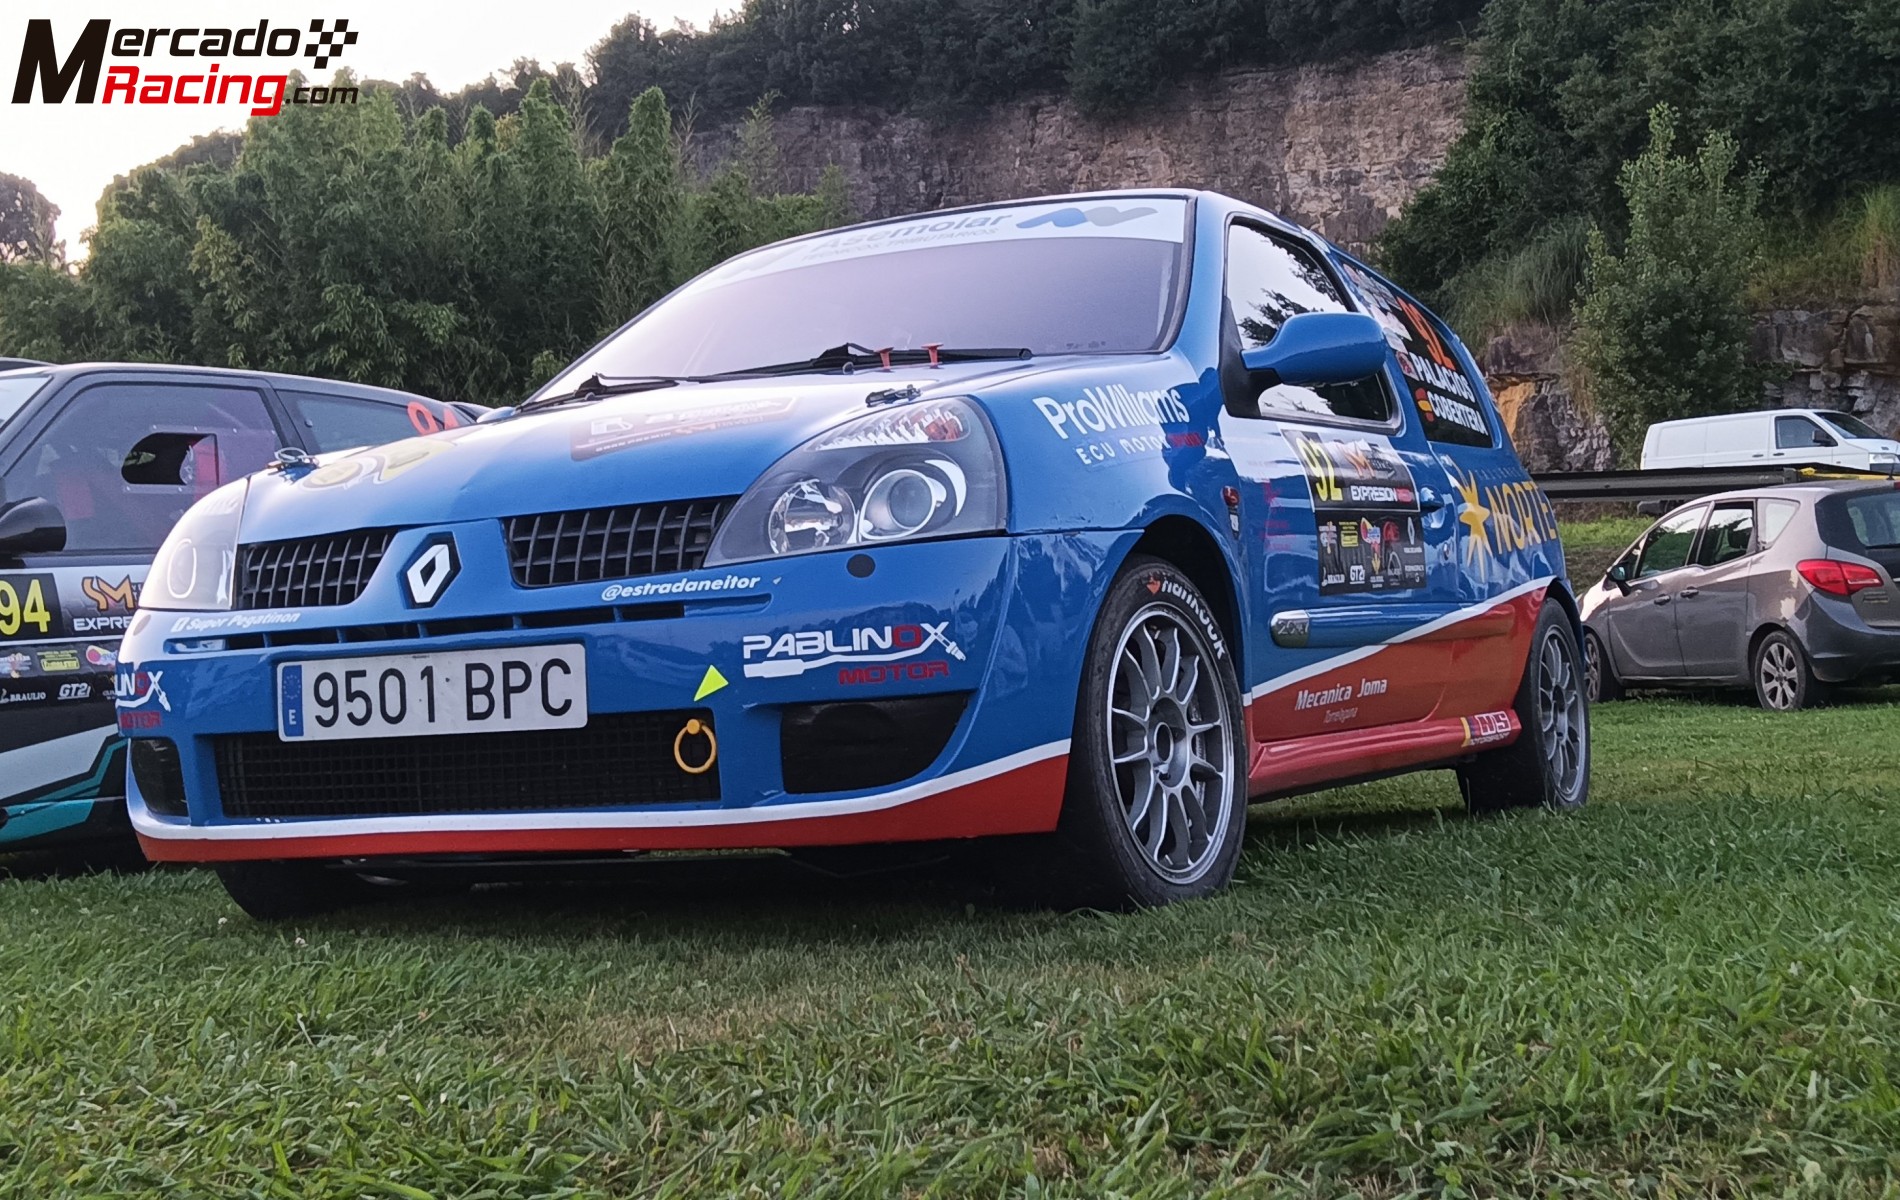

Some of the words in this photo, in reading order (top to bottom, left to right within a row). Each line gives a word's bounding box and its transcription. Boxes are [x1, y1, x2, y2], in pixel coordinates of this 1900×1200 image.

[811, 214, 1013, 252] Asemolar
[1408, 350, 1476, 403] PALACIOS
[1427, 390, 1489, 436] COBERTERA
[1076, 439, 1116, 465] ECU
[1119, 433, 1172, 456] MOTOR
[1296, 437, 1343, 501] 92
[601, 574, 761, 600] @estradaneitor
[0, 578, 51, 636] 94
[743, 621, 950, 660] PABLINOX
[838, 661, 949, 685] MOTOR
[10, 691, 47, 703] BRAULIO
[288, 709, 297, 725] E
[313, 665, 435, 728] 9501
[465, 658, 573, 721] BPC
[1294, 683, 1353, 711] Mecanica
[1356, 678, 1388, 698] Joma
